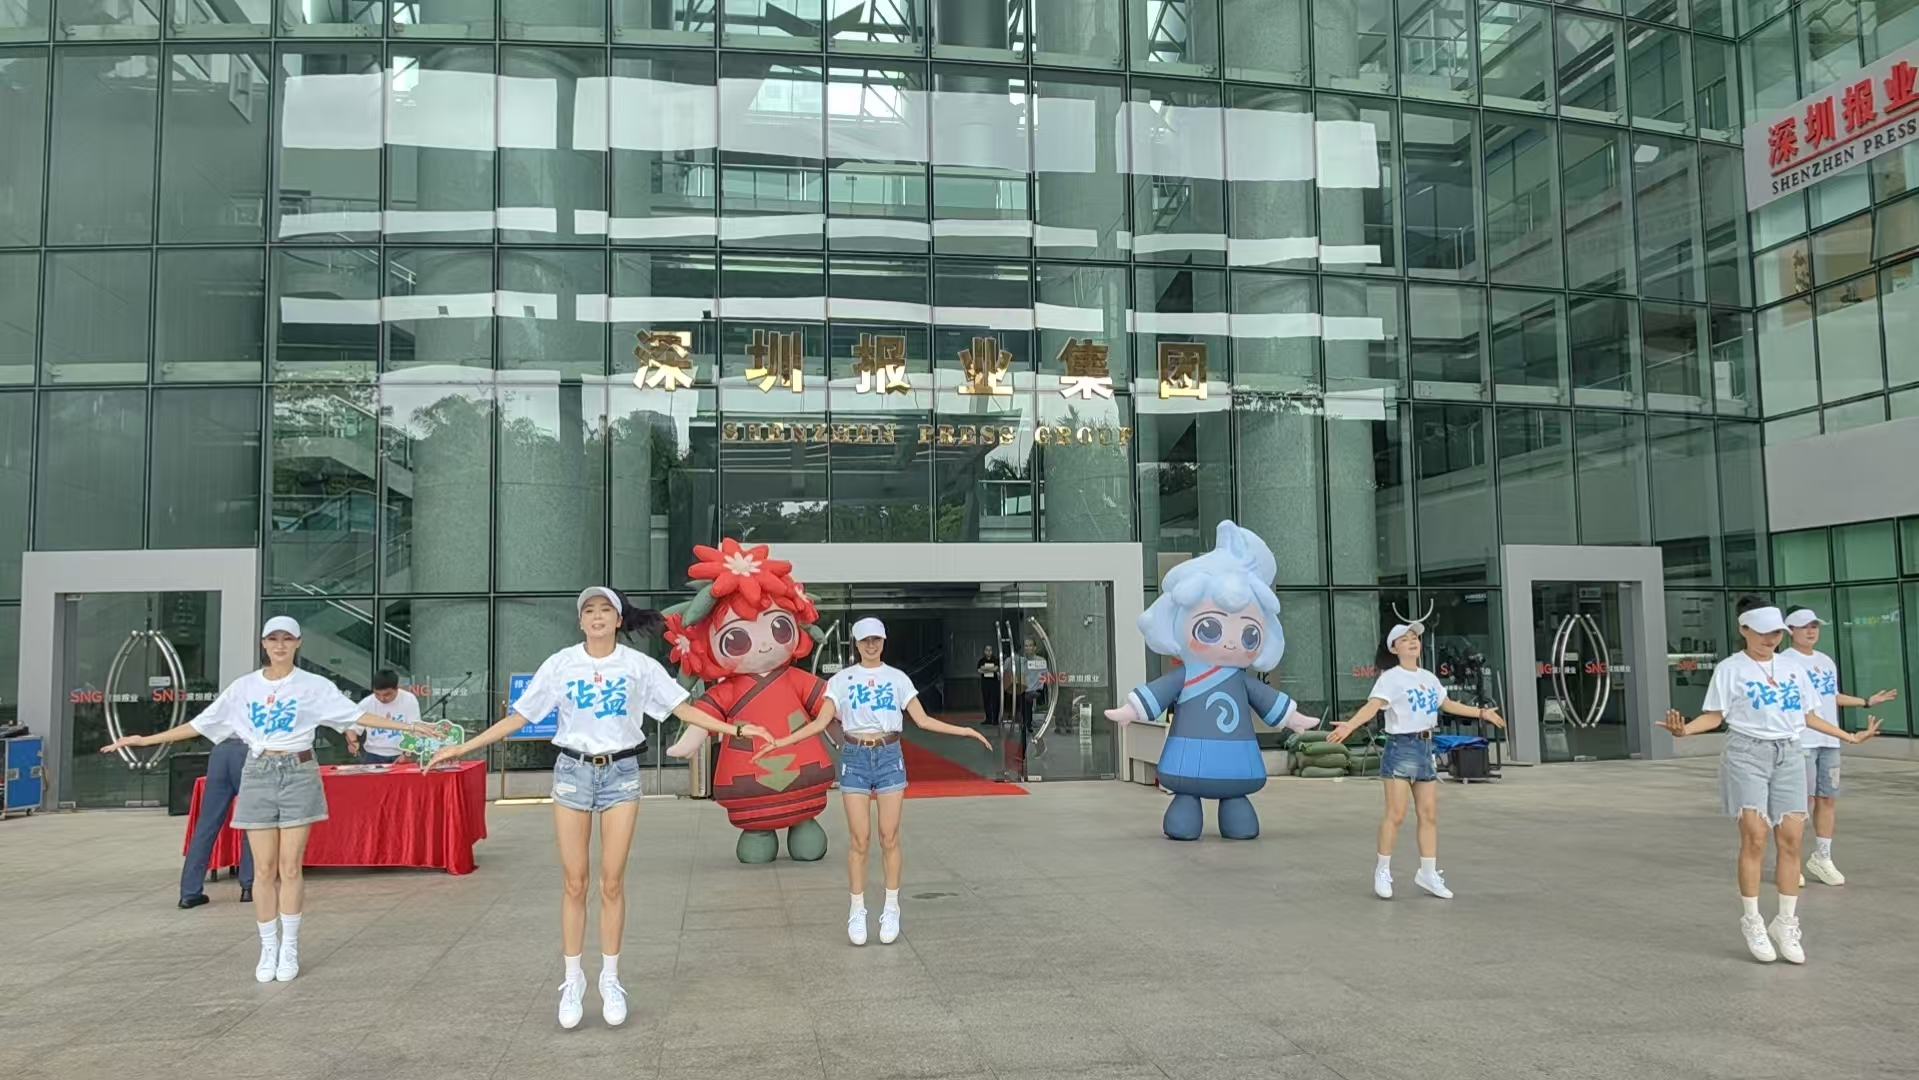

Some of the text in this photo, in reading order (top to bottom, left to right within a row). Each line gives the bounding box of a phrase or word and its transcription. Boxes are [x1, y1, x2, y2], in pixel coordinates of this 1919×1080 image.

[1768, 60, 1919, 168] 深圳报业
[1771, 118, 1917, 195] SHENZHEN PRESS
[632, 327, 1208, 400] 深圳报业集团
[722, 421, 1134, 446] SHENZHEN PRESS GROUP
[70, 690, 103, 703] SNG
[152, 688, 187, 702] SNG
[566, 677, 628, 720] 沾益
[848, 682, 897, 712] 沾益
[1406, 687, 1439, 715] 沾益
[1746, 679, 1801, 713] 沾益
[246, 698, 297, 735] 沾益
